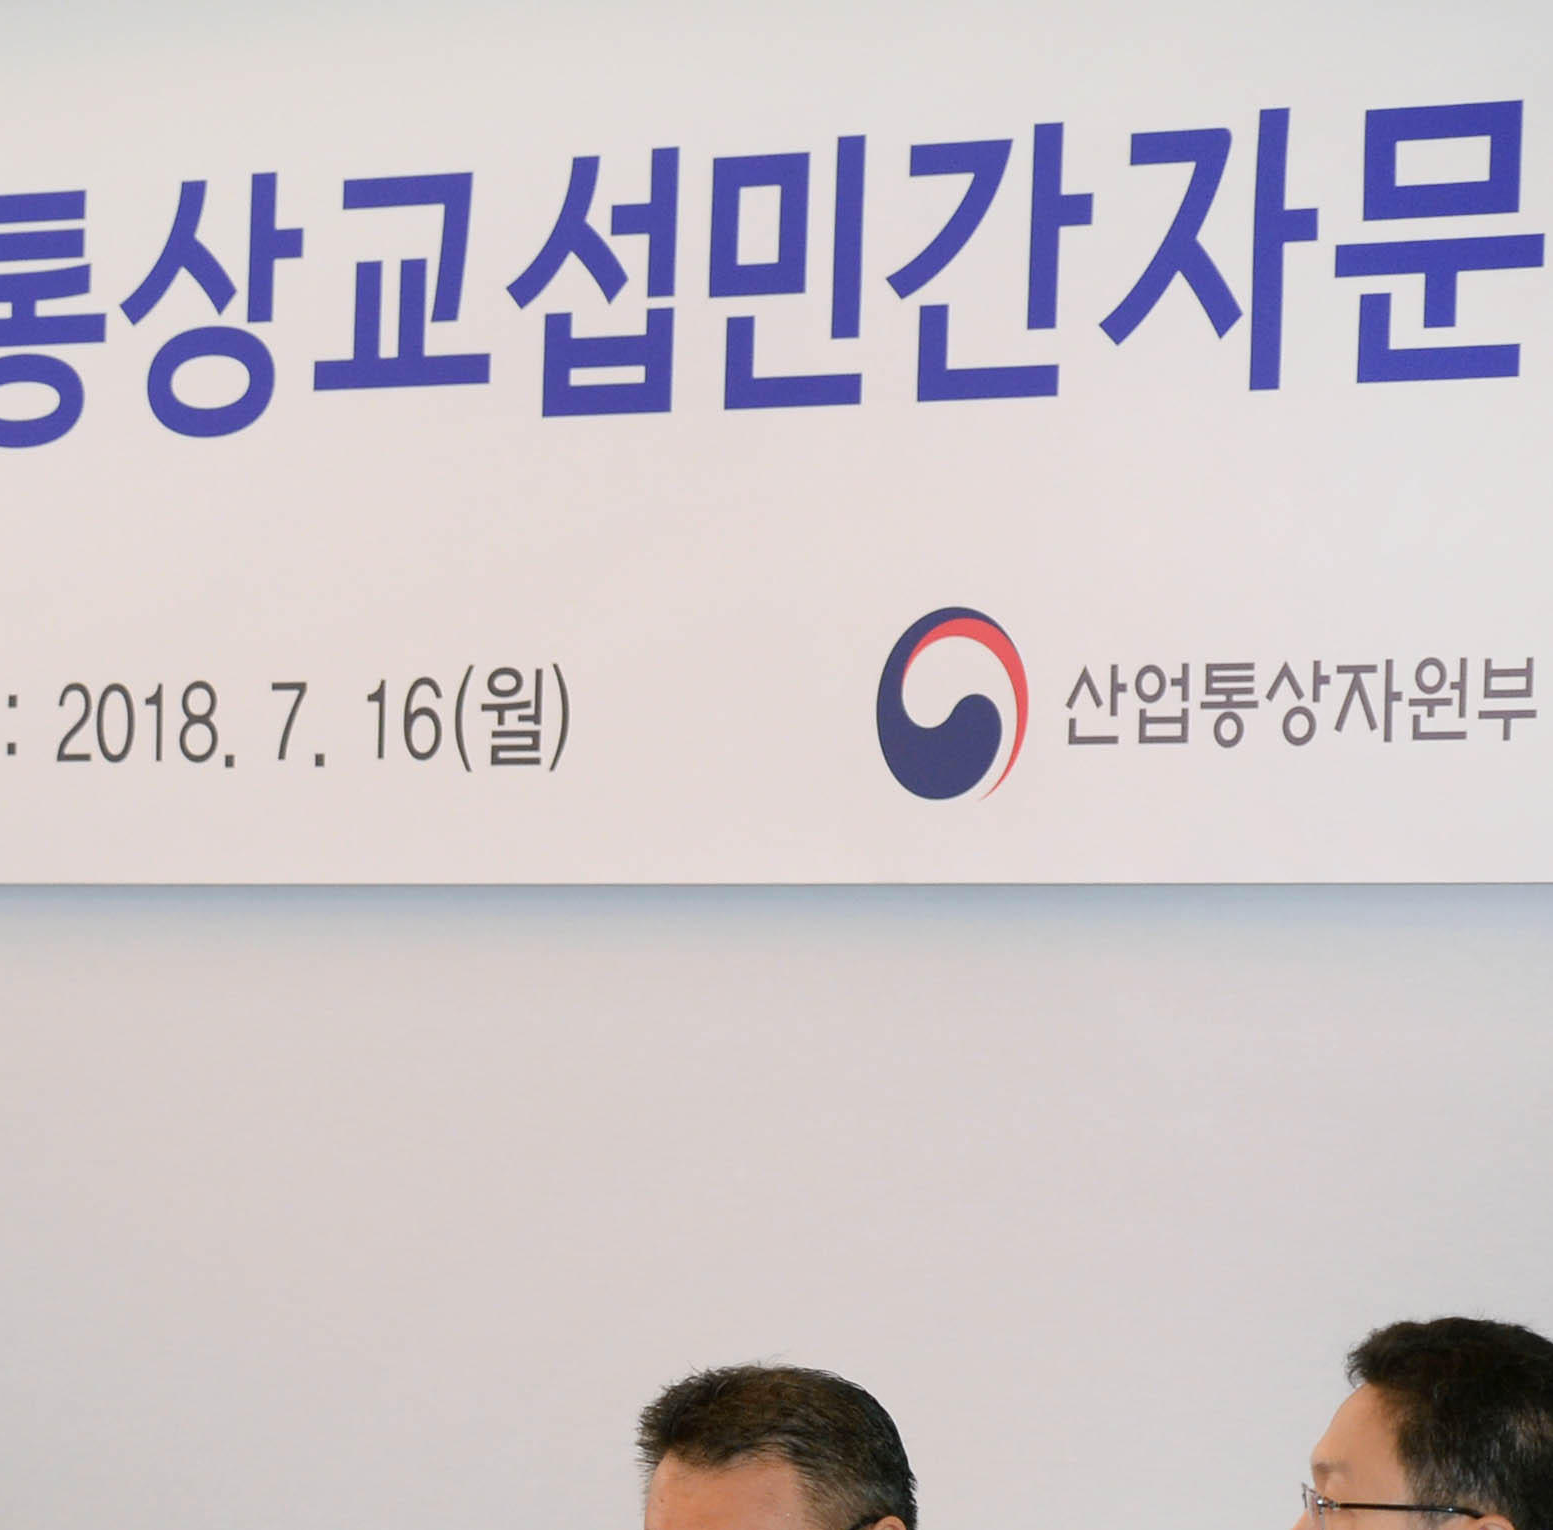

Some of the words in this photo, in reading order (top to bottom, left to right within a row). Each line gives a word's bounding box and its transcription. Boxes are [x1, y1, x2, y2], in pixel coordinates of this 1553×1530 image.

[55, 680, 235, 769] 2018.
[271, 681, 325, 769] 7.
[366, 664, 570, 774] 16(월)
[1065, 656, 1537, 750] 산업통상자원부
